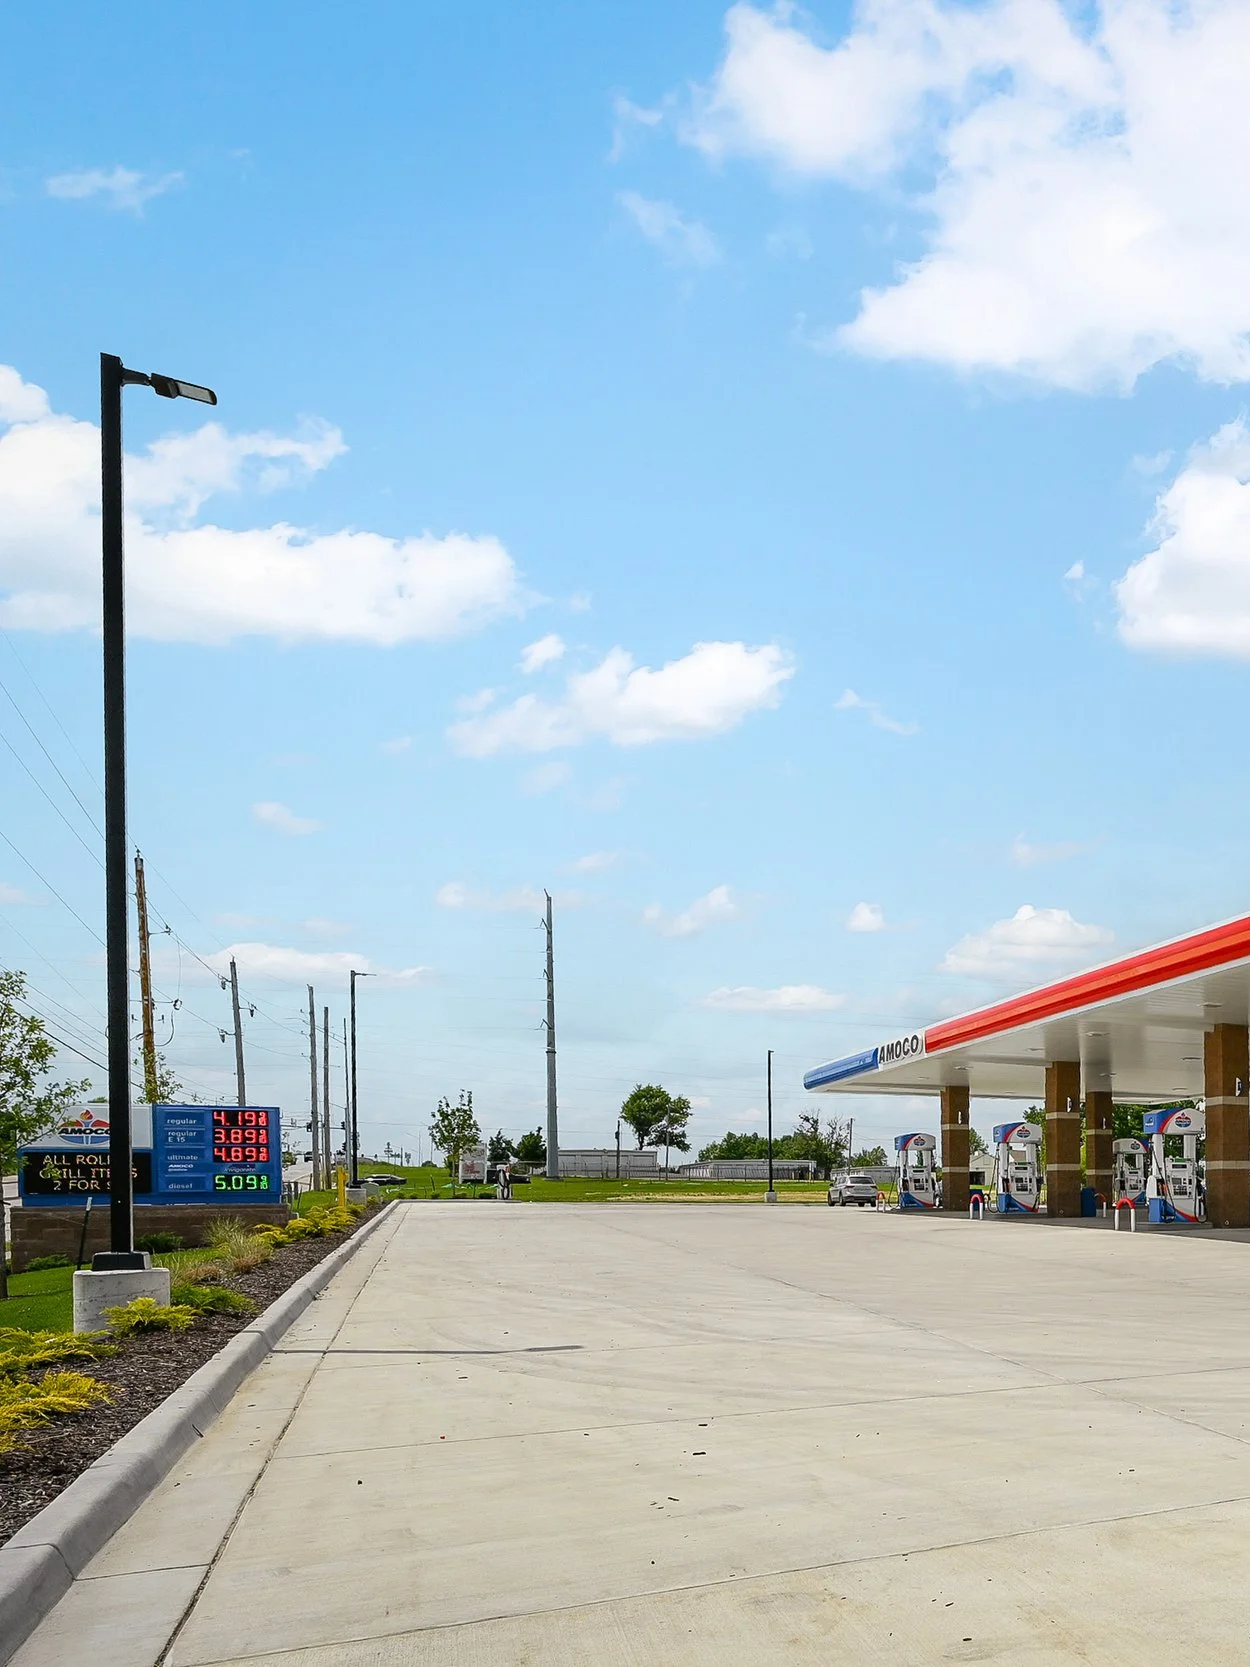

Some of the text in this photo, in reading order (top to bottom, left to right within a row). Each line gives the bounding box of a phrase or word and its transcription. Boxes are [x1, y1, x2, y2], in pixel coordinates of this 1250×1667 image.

[879, 1034, 919, 1063] AMOCO
[43, 1155, 71, 1165] ALL
[53, 1181, 61, 1191] 2
[69, 1180, 100, 1191] FOR
